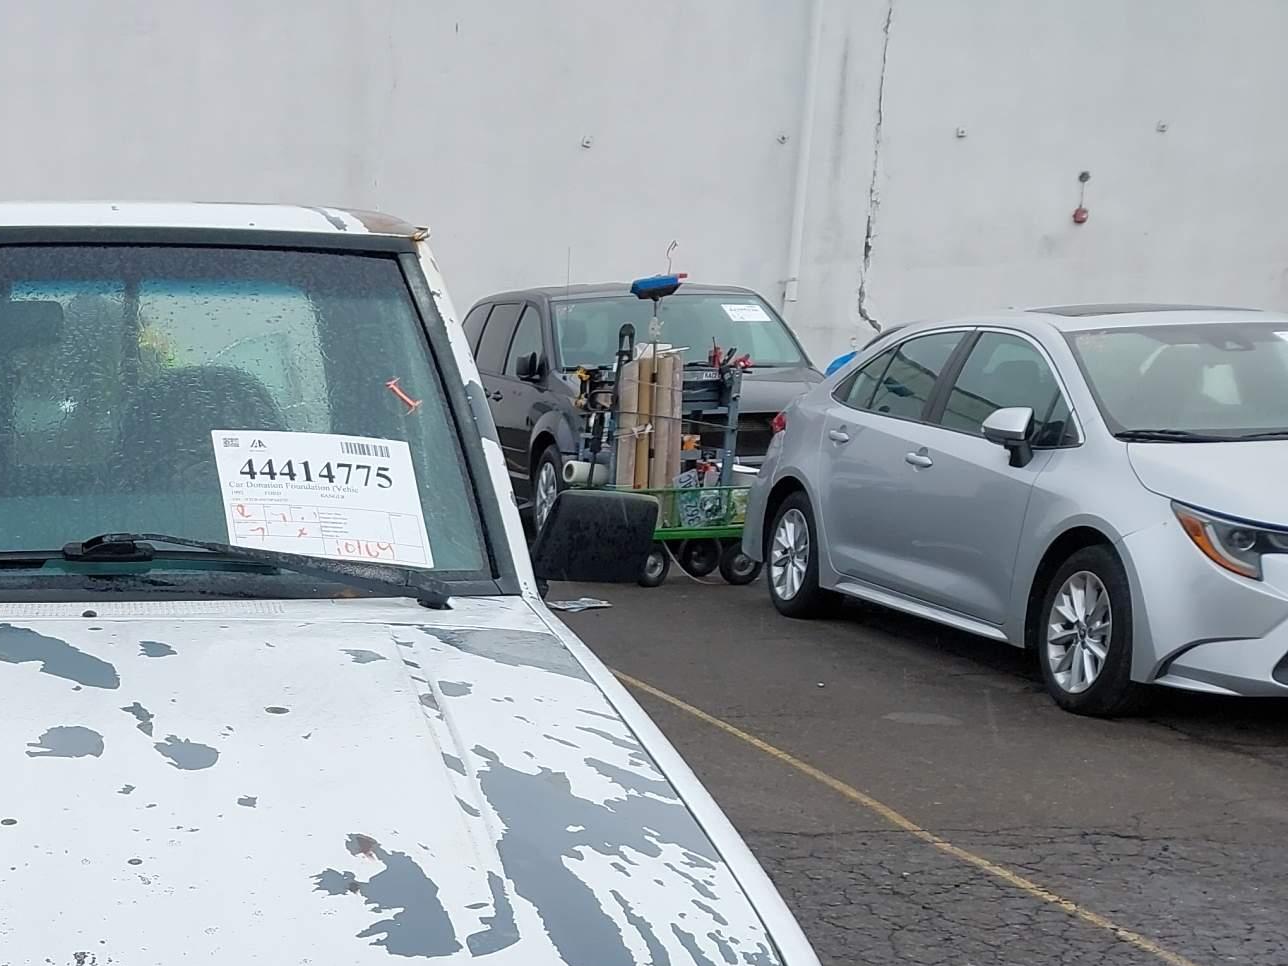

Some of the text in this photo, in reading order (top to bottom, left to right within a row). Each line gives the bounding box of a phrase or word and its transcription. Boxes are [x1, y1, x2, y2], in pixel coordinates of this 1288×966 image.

[239, 457, 393, 489] 44414775
[228, 480, 244, 489] Car
[246, 480, 284, 490] Donation
[285, 482, 330, 492] Foundation
